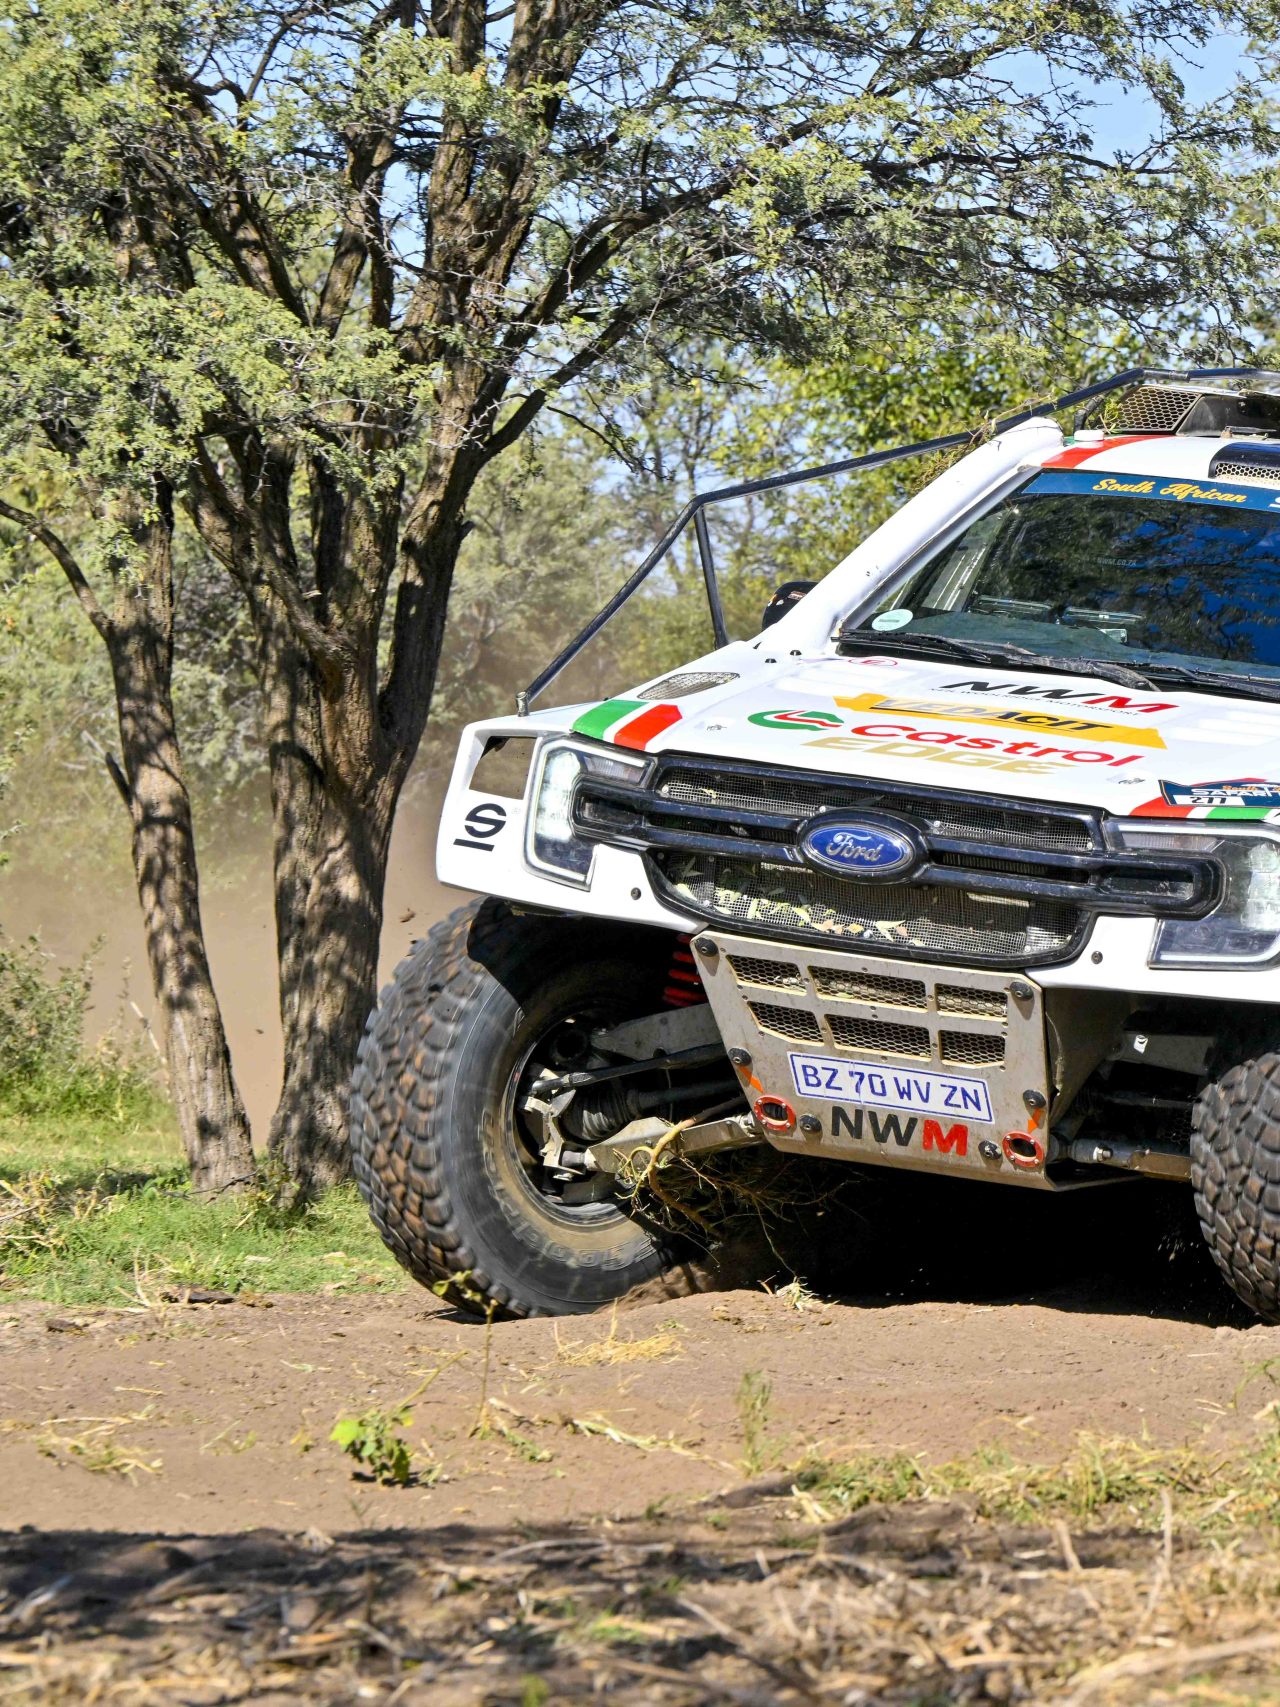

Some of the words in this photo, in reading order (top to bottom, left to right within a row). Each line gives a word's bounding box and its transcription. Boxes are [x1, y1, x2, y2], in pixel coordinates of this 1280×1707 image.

[1093, 479, 1156, 494] South
[1160, 483, 1247, 503] African
[939, 681, 1180, 713] NWM
[874, 699, 1115, 732] VEDACIT
[800, 737, 1082, 775] EDGE
[851, 724, 1145, 767] Castrol
[826, 832, 884, 862] Ford
[801, 1064, 843, 1092] BZ
[848, 1070, 887, 1097] 70
[894, 1076, 930, 1103] WV
[940, 1083, 982, 1112] ZN
[831, 1106, 968, 1156] NWM
